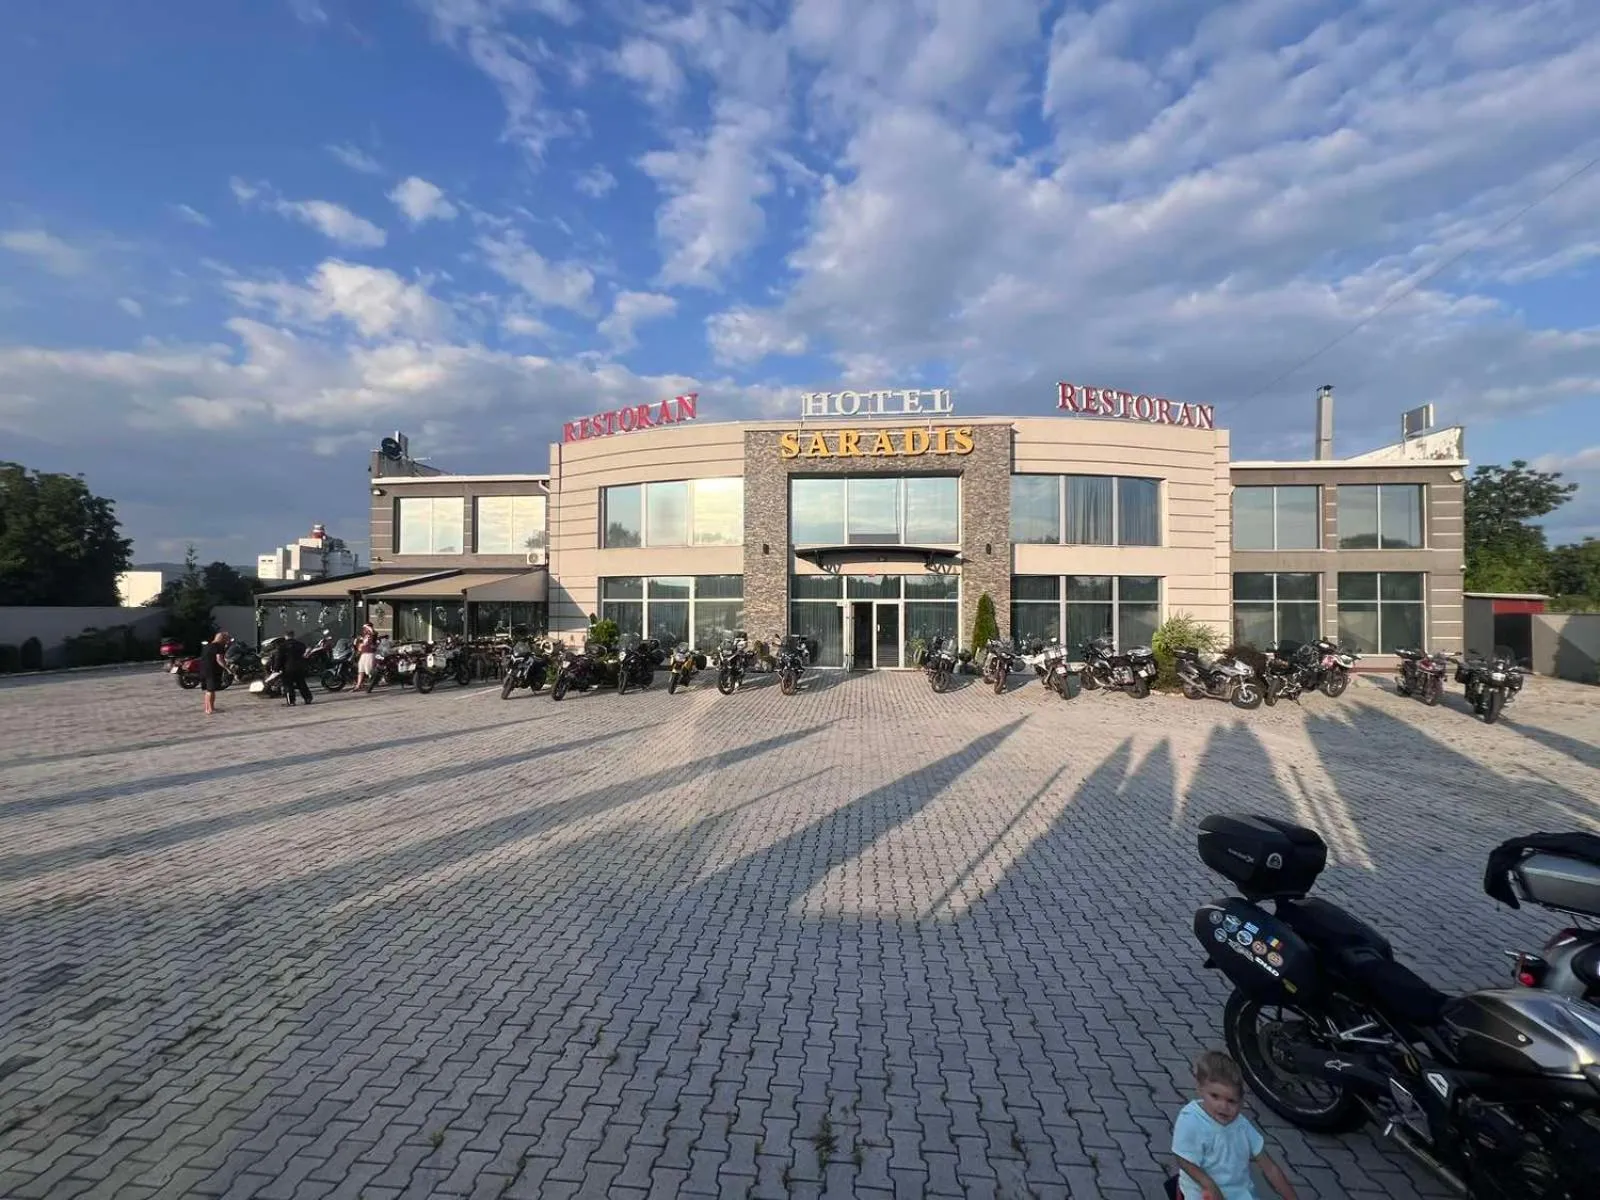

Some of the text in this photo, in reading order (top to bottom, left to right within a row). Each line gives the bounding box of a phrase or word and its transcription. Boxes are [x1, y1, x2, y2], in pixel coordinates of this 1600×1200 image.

[562, 393, 698, 442] RESTORAN
[803, 389, 954, 415] HOTEL
[1056, 381, 1214, 429] RESTORAN
[780, 427, 975, 459] SARADIS
